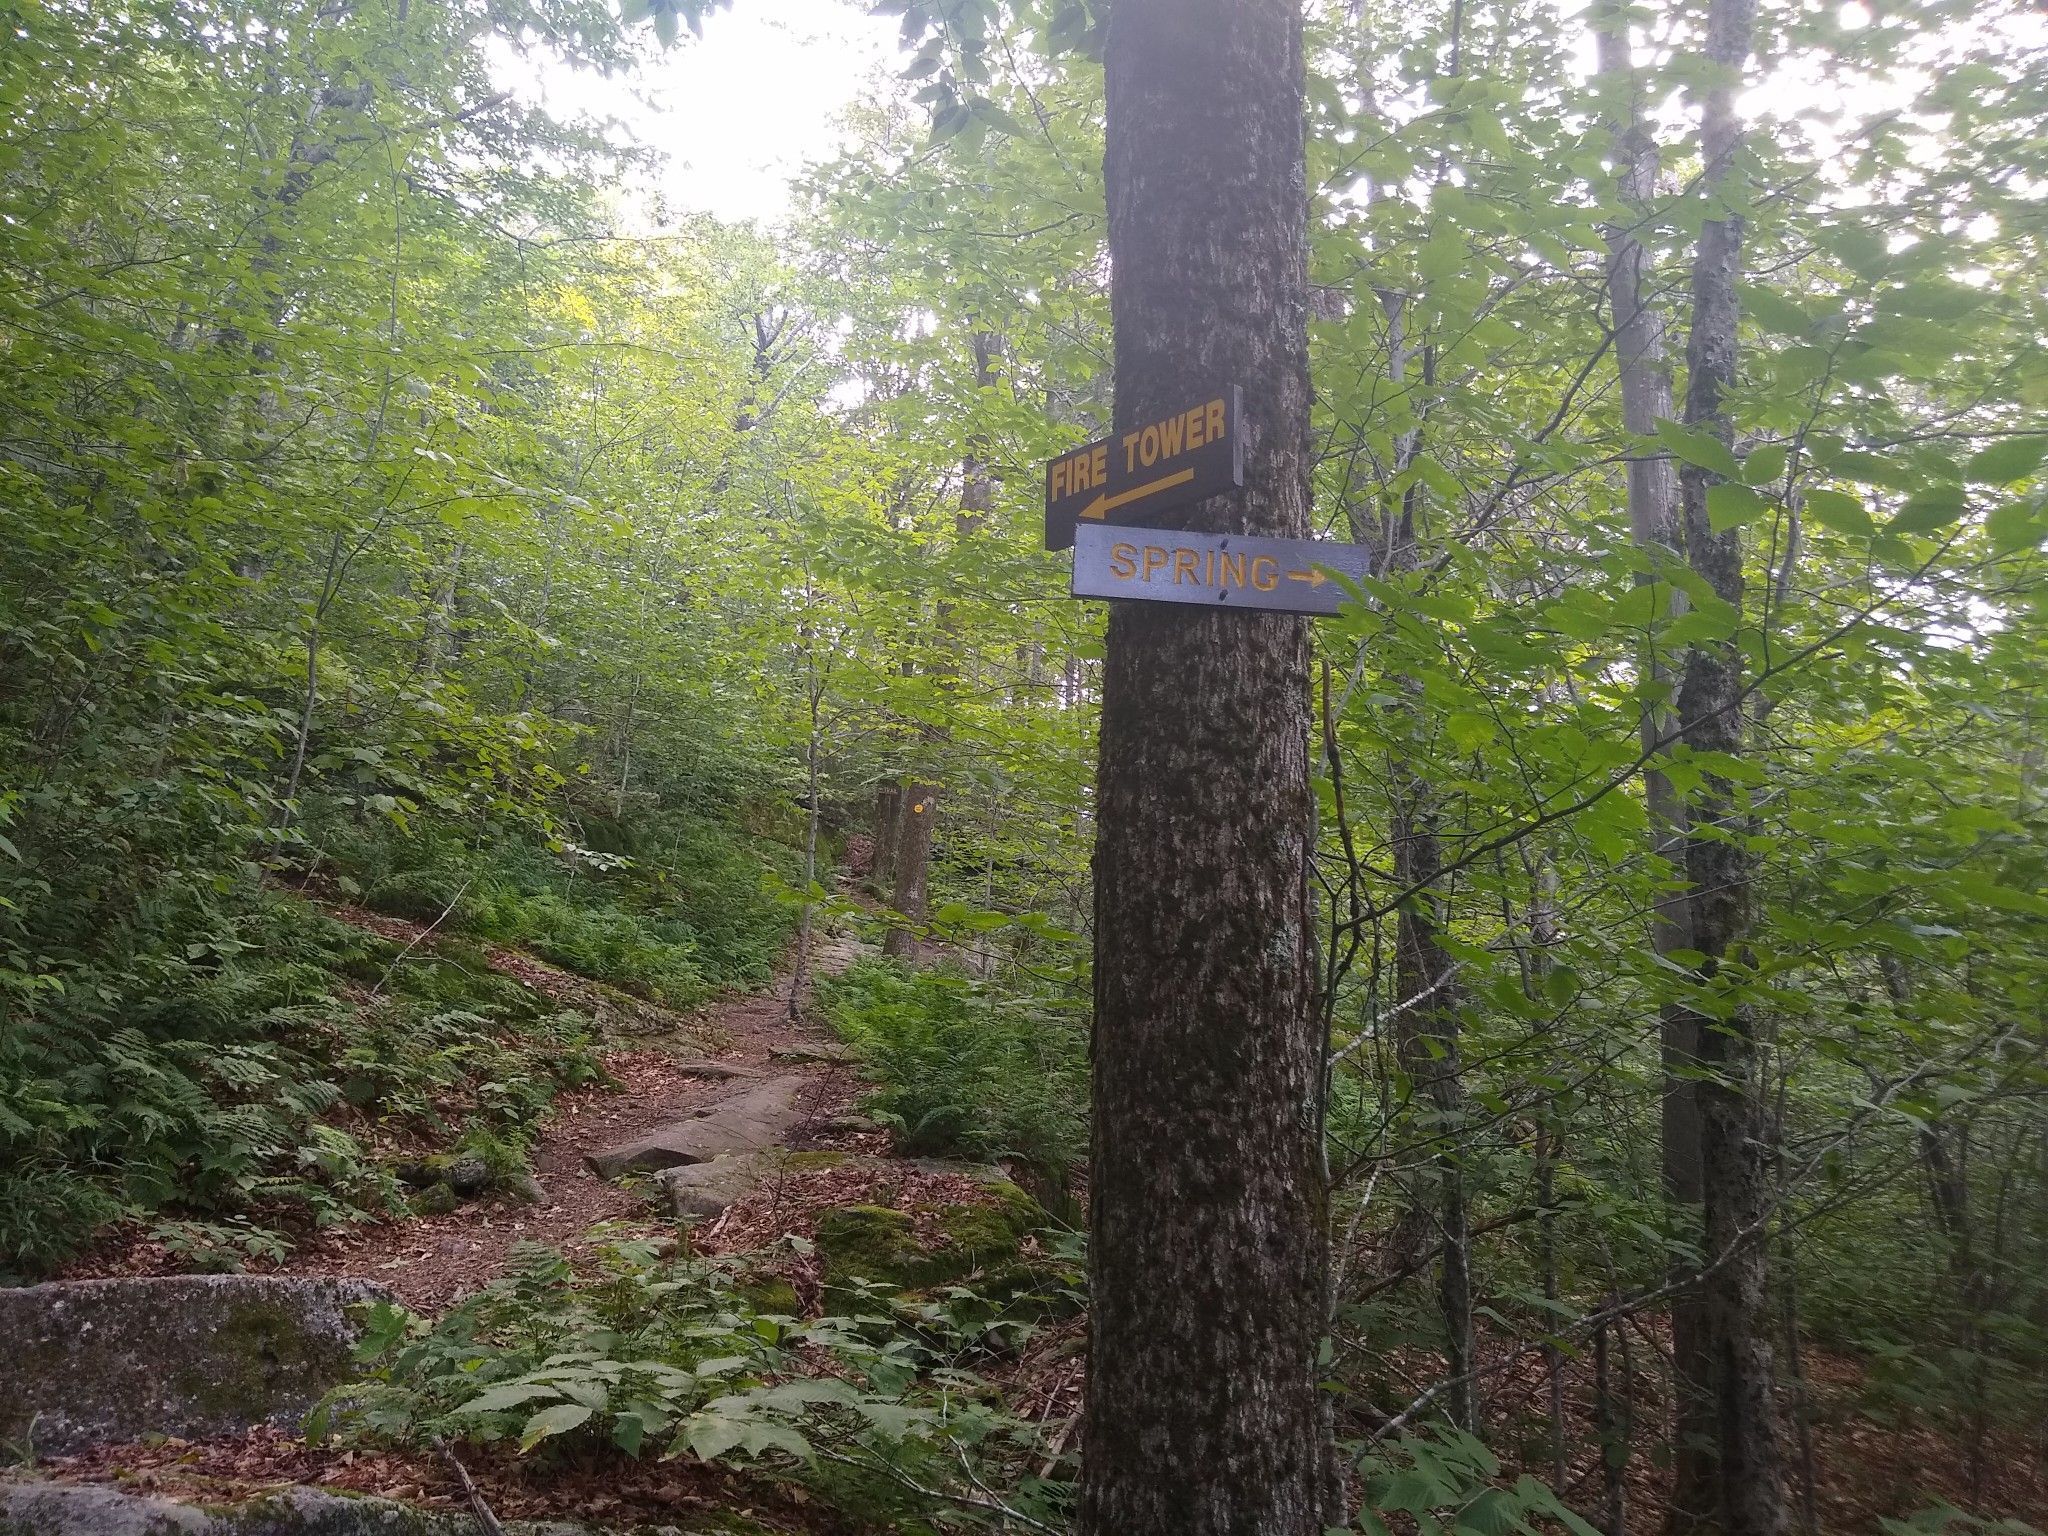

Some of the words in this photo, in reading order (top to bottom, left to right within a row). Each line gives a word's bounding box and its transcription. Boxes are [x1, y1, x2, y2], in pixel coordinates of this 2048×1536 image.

[1051, 445, 1108, 502] FIRE
[1122, 399, 1225, 473] TOWER
[1109, 542, 1280, 592] SPRING
